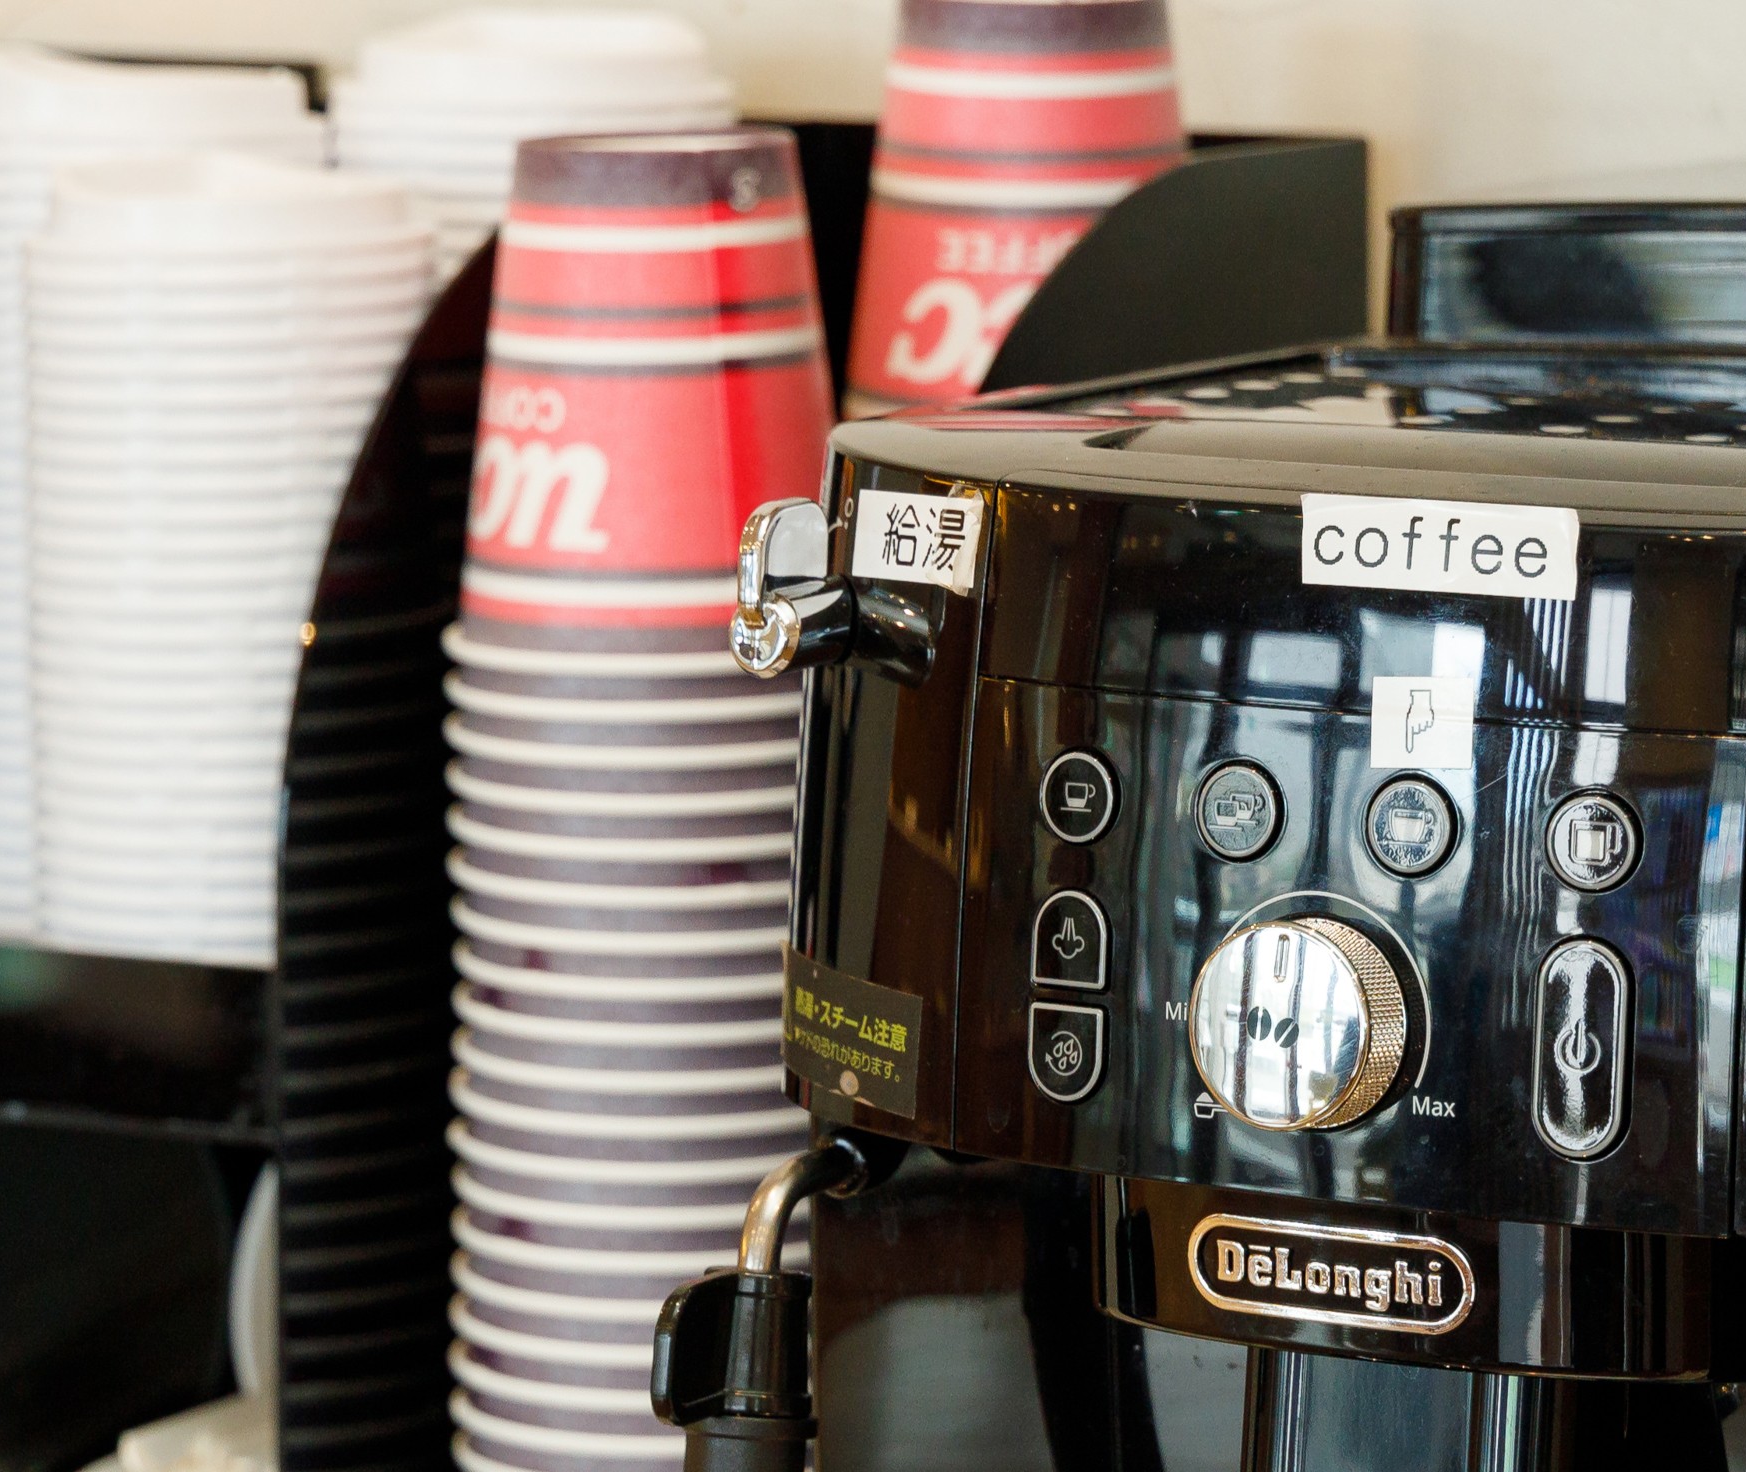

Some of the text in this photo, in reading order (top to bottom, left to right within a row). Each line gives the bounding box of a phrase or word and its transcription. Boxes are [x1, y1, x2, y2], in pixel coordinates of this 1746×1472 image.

[882, 503, 965, 572] 給湯
[1313, 516, 1548, 578] coffee
[1165, 1001, 1187, 1021] Mi
[1412, 1096, 1456, 1118] Max
